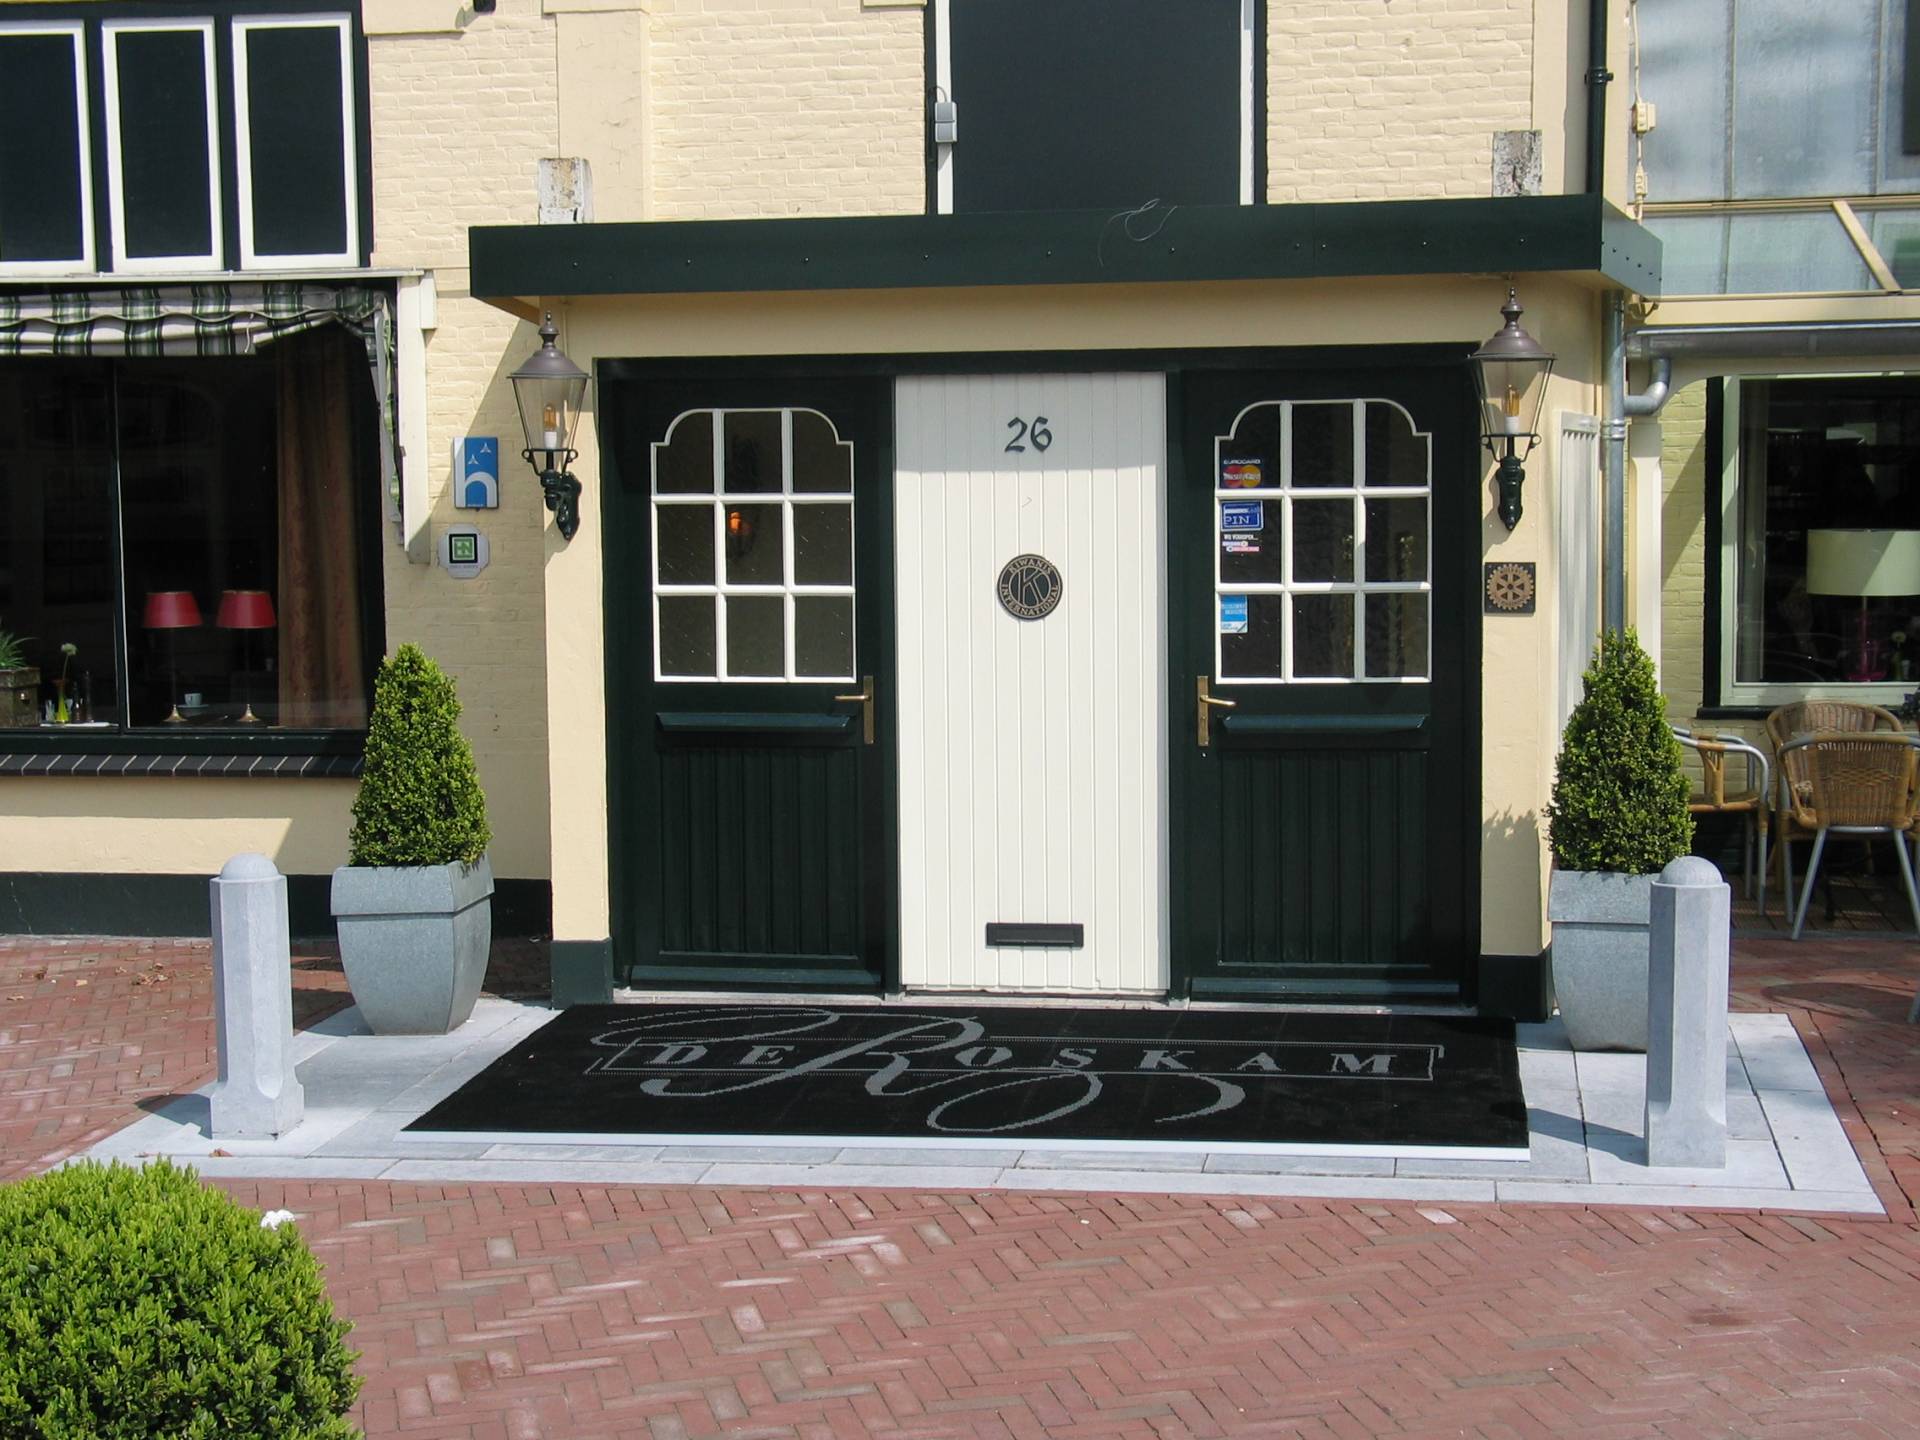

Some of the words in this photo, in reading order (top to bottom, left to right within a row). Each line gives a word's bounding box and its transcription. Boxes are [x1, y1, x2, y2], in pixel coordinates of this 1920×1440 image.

[1004, 416, 1053, 453] 26
[1009, 559, 1053, 574] KIWANIS
[1001, 584, 1059, 616] INTERNATIONAL
[643, 1044, 794, 1066] DE
